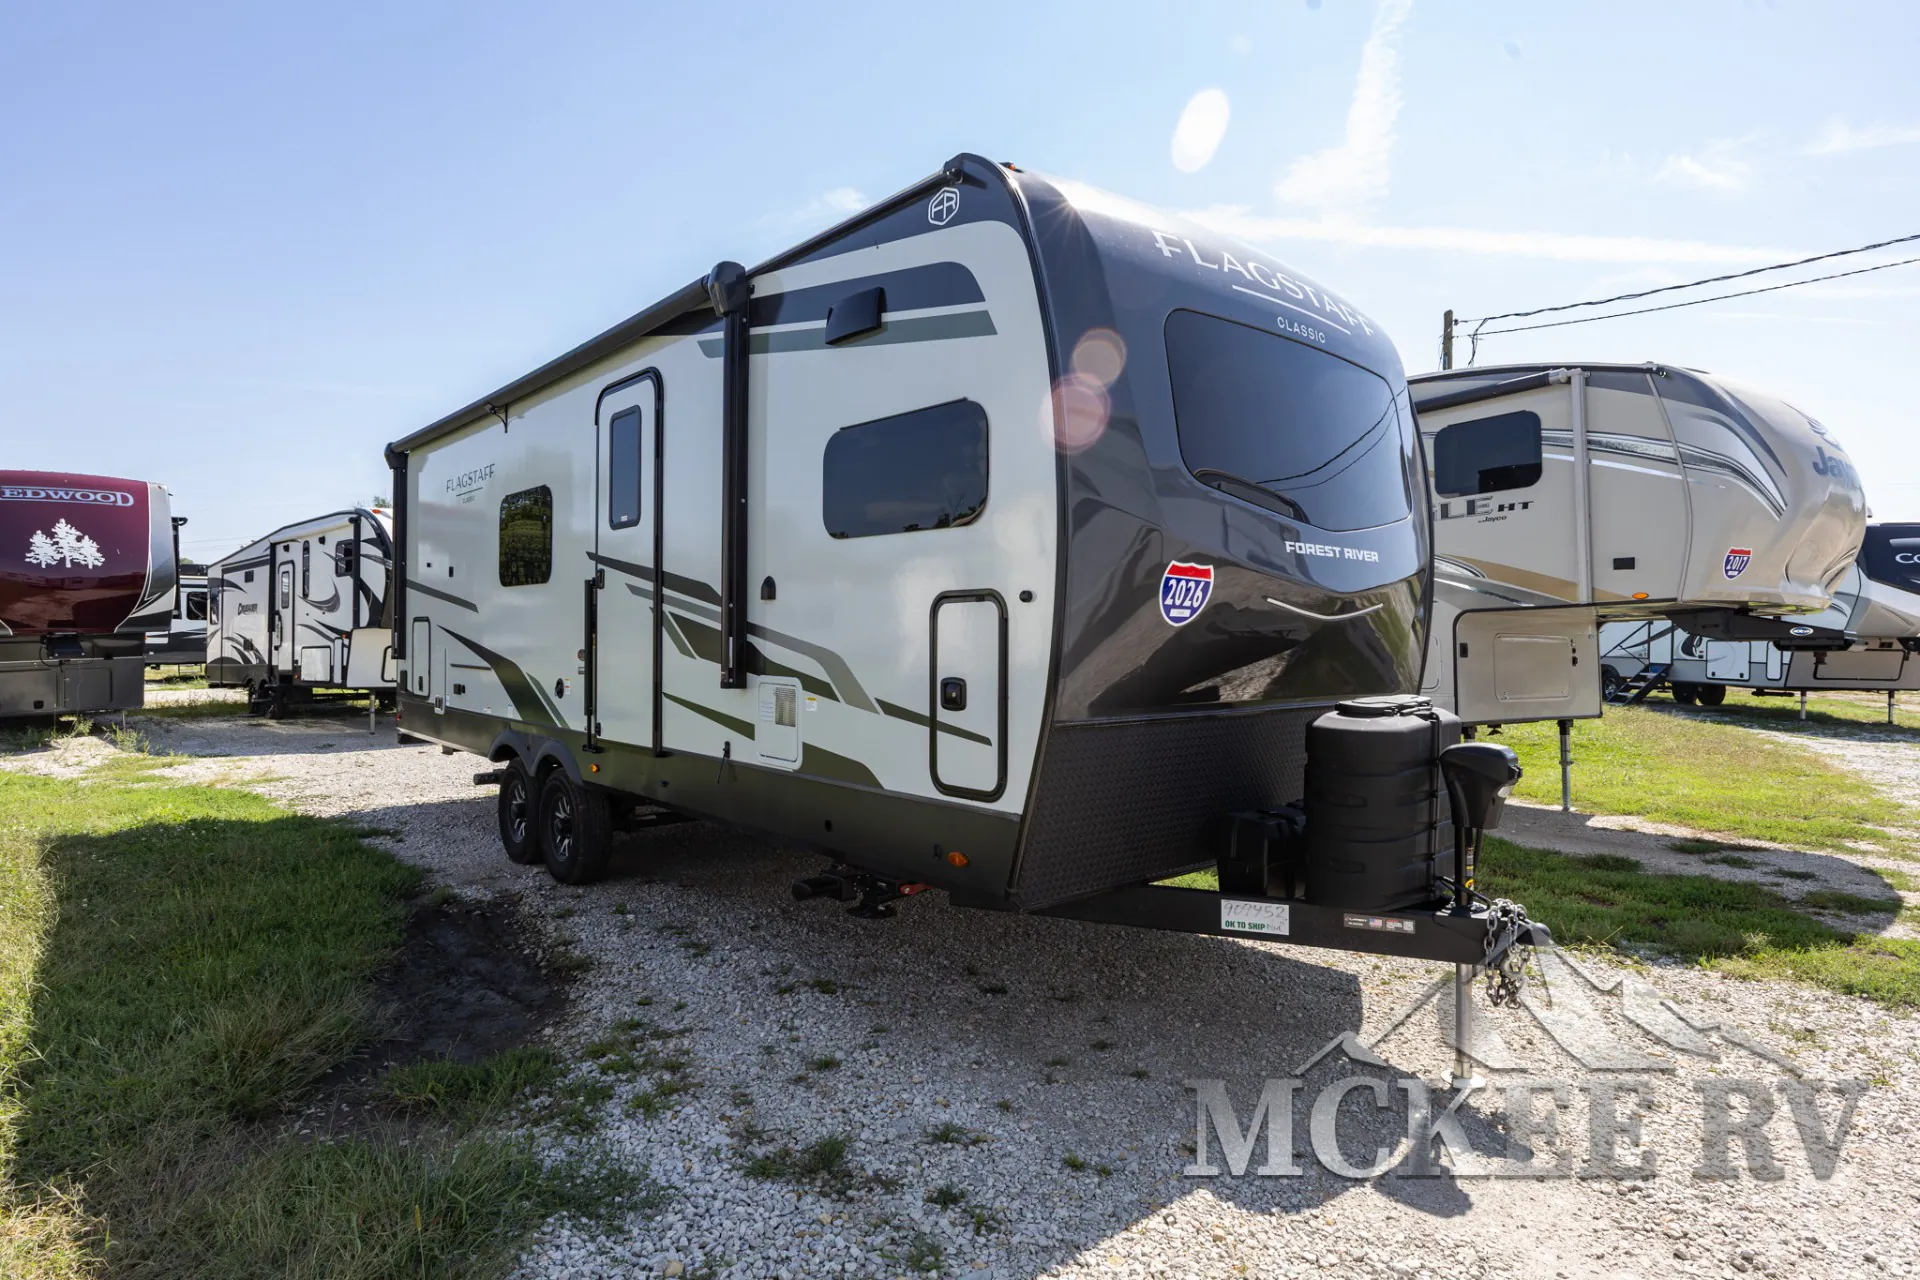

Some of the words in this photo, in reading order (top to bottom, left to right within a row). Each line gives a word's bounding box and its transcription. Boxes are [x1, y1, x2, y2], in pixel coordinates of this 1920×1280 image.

[1151, 230, 1374, 337] FLAGSTAFF
[1276, 316, 1326, 344] CLASSIC
[446, 463, 496, 493] FLAGSTAFF
[0, 488, 134, 507] EDWOOD
[1284, 541, 1341, 558] FOREST
[1343, 547, 1379, 563] RIVER
[1725, 555, 1748, 571] 2017
[1164, 578, 1206, 608] 2026
[1225, 920, 1236, 929] OK
[1236, 921, 1246, 929] TO
[1248, 922, 1265, 931] SHIP
